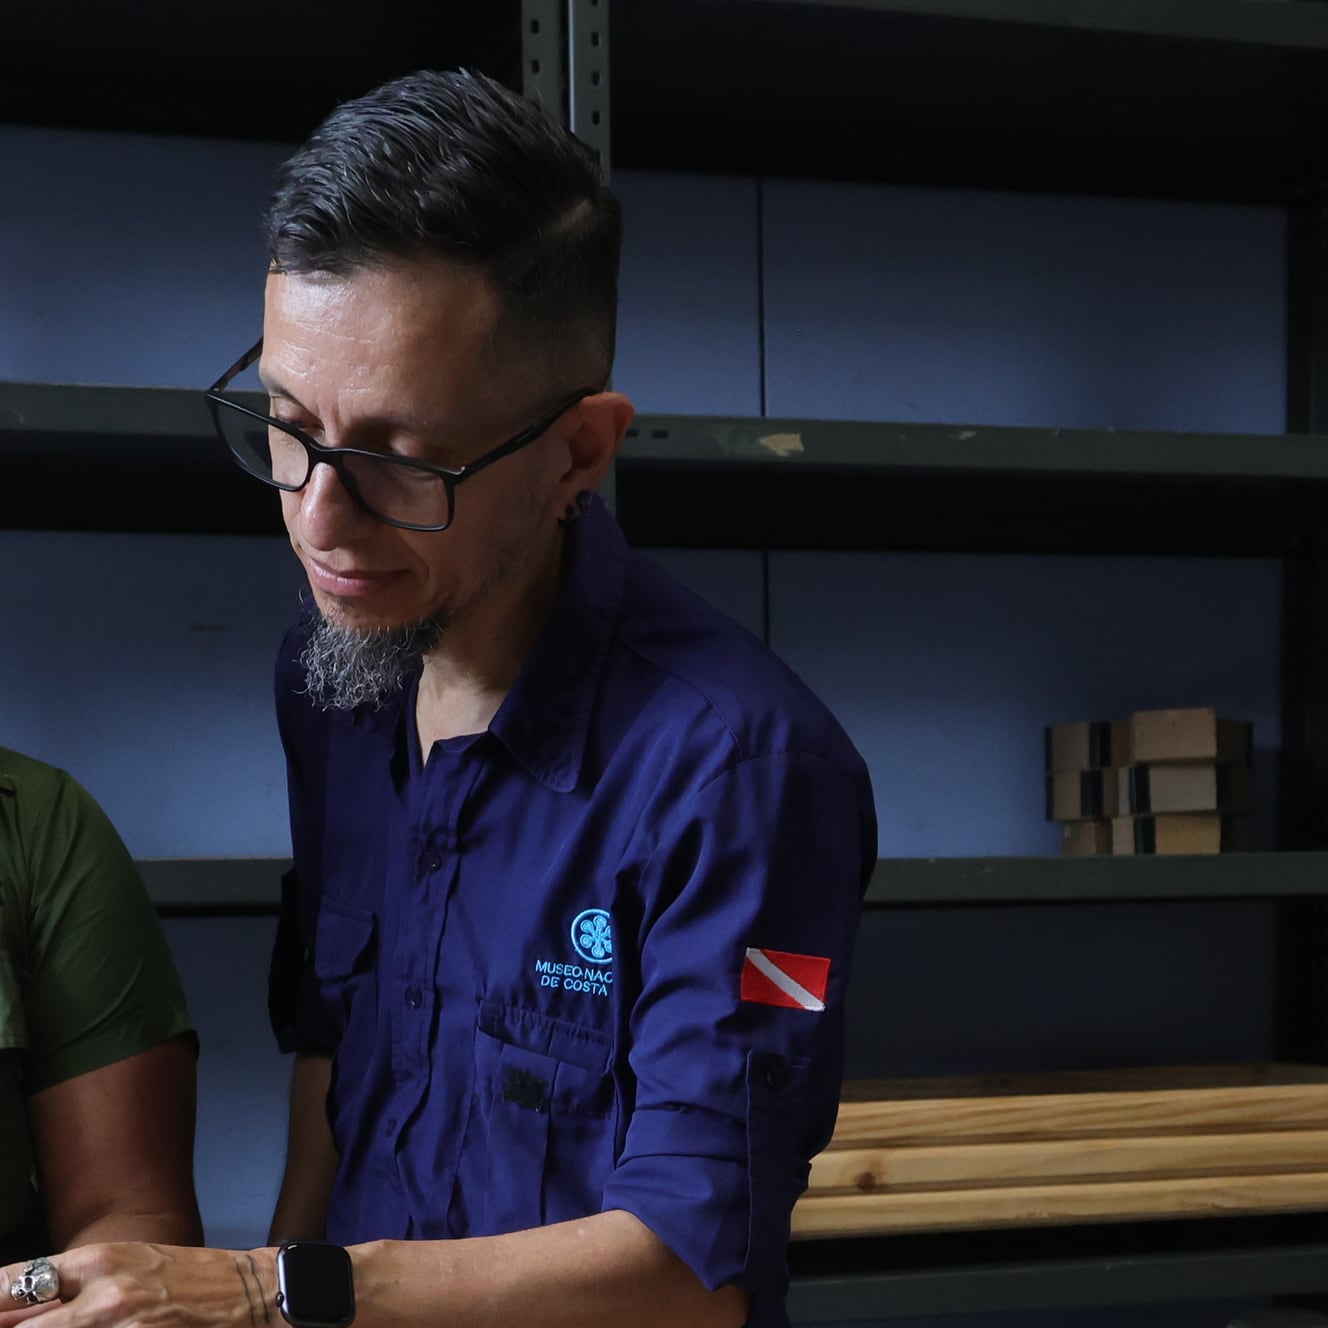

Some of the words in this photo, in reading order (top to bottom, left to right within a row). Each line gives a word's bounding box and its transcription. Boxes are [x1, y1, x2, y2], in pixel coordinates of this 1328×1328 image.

[535, 959, 583, 978] MUSEO
[540, 975, 560, 988] DE
[563, 978, 608, 997] COSTA
